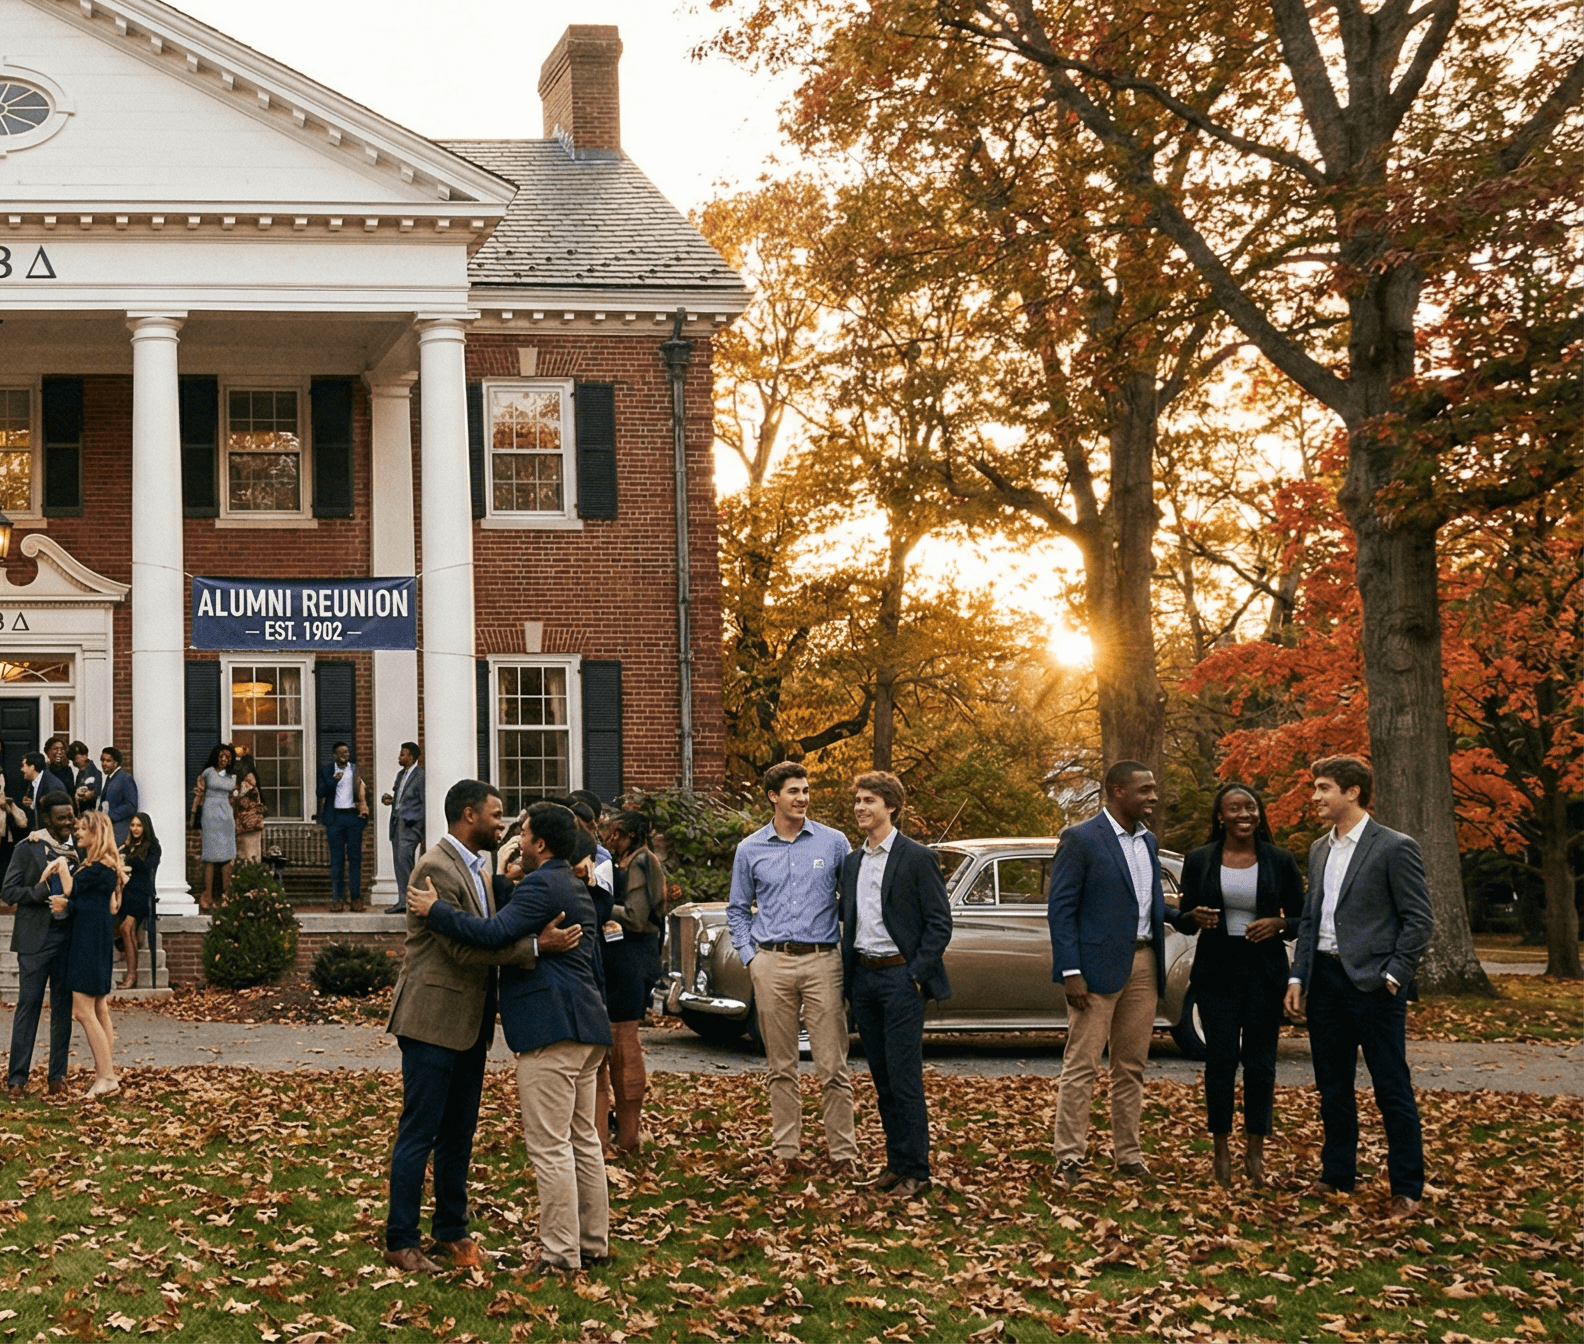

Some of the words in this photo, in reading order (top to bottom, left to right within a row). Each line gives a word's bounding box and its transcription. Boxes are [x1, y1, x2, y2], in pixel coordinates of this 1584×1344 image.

[197, 588, 292, 617] ALUMNI
[302, 588, 409, 617] REUNION
[265, 621, 297, 641] EST.
[303, 621, 343, 641] 1902
